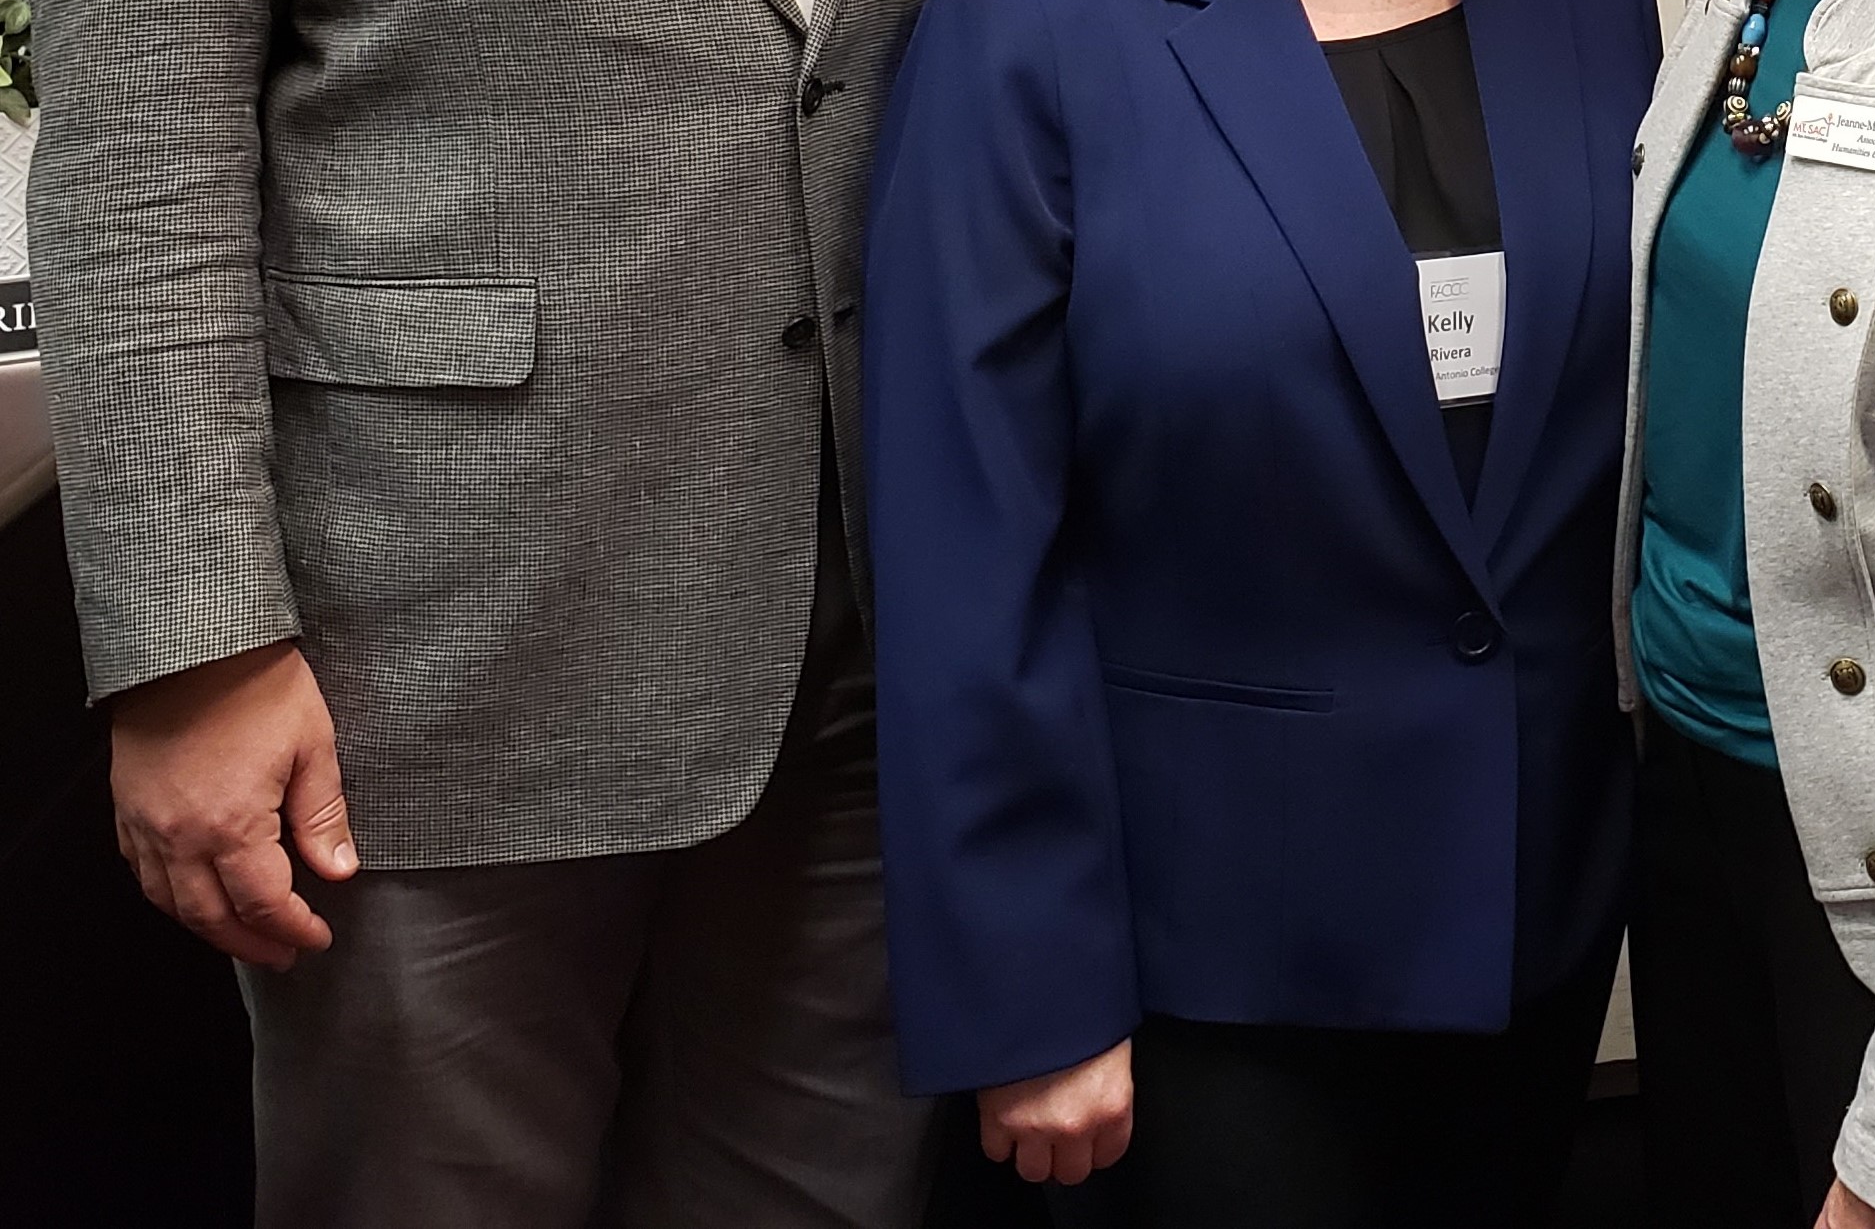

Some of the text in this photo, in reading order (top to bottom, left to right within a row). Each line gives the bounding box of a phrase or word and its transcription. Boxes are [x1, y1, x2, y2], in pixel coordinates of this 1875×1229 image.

[1831, 142, 1870, 157] Humanities
[1431, 281, 1470, 298] FACCC
[1428, 311, 1474, 333] Kelly
[1430, 347, 1471, 362] Rivera
[1436, 369, 1469, 380] Antonio
